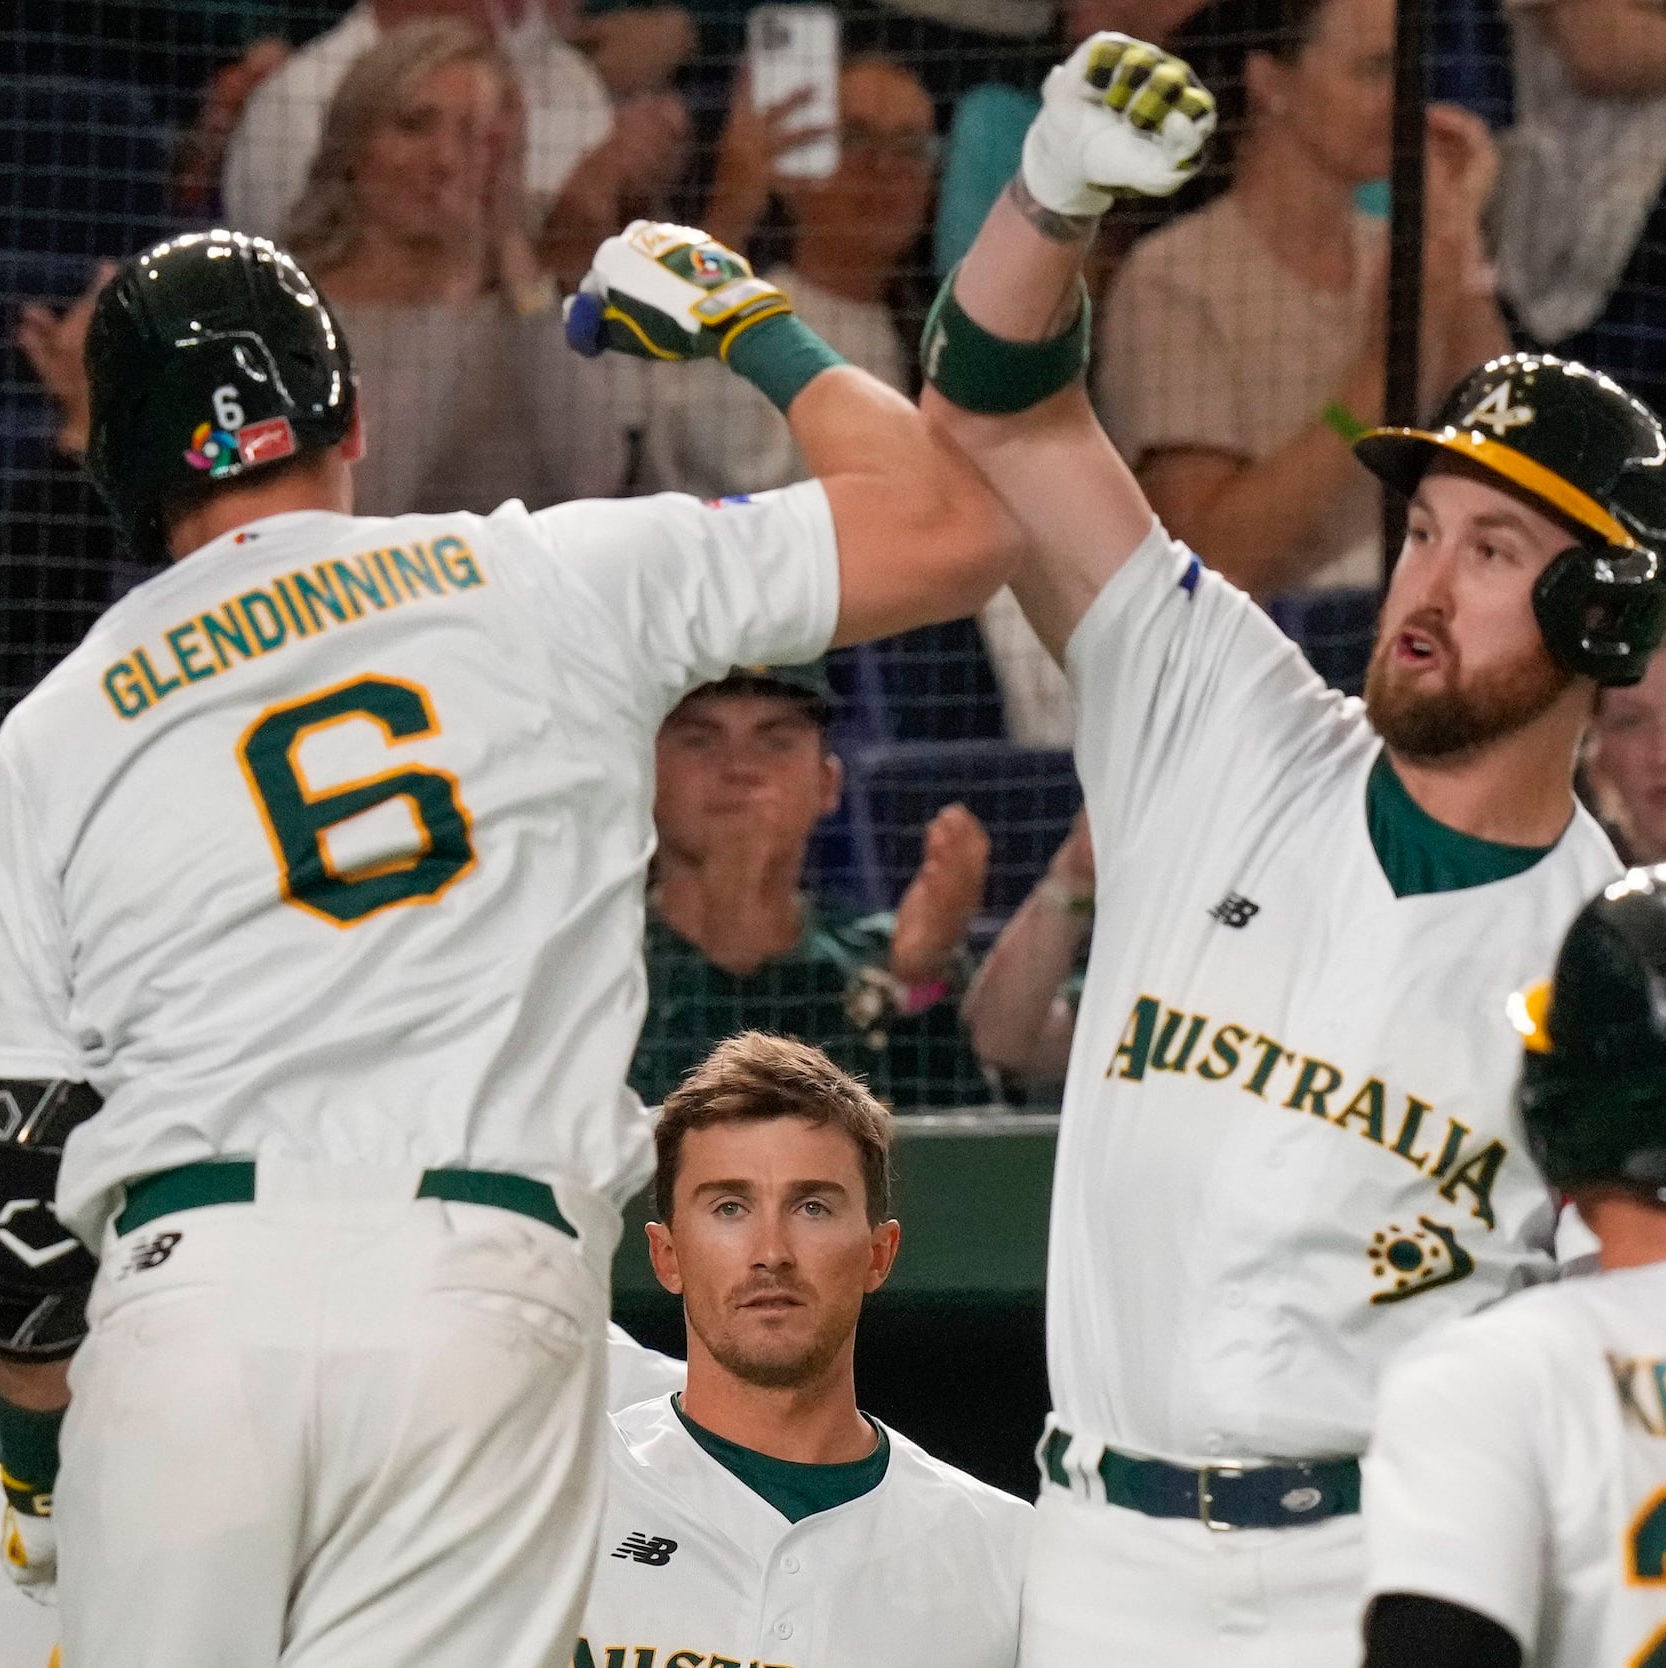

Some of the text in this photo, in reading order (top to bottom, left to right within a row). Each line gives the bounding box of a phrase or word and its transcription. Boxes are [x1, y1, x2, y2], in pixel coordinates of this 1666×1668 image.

[212, 385, 245, 431] 6
[101, 535, 487, 722] GLENDINNING
[236, 672, 478, 930] 6
[1105, 993, 1507, 1231] AUSTRALIA
